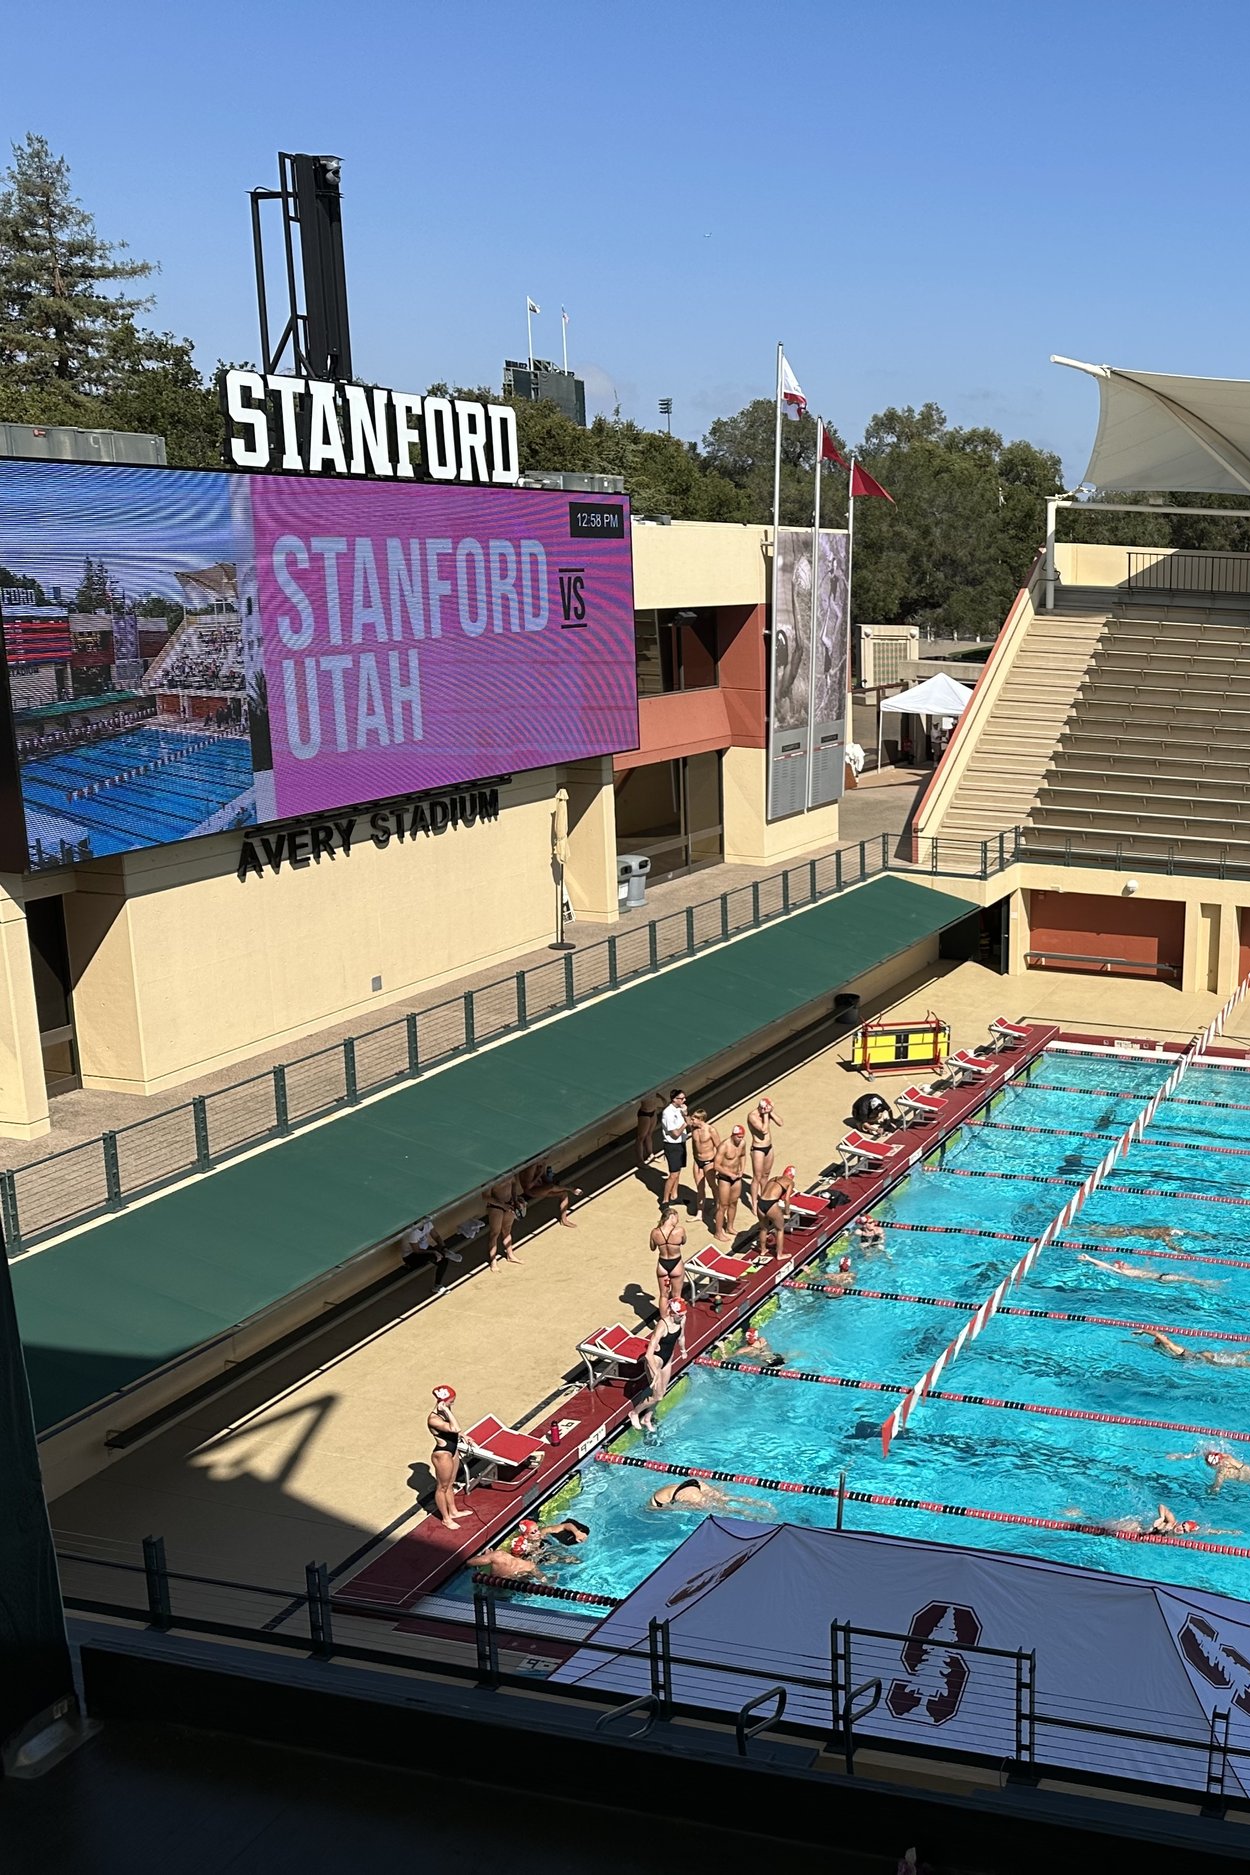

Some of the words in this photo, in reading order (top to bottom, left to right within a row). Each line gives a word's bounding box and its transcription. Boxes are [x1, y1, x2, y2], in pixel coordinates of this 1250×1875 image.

[226, 370, 519, 483] STANFORD
[577, 513, 602, 528] 12:58
[603, 513, 619, 528] PM
[272, 534, 549, 650] STANFORD
[559, 576, 585, 621] VS
[282, 649, 424, 760] UTAH
[237, 818, 357, 880] AVERY
[370, 788, 499, 846] STADIUM
